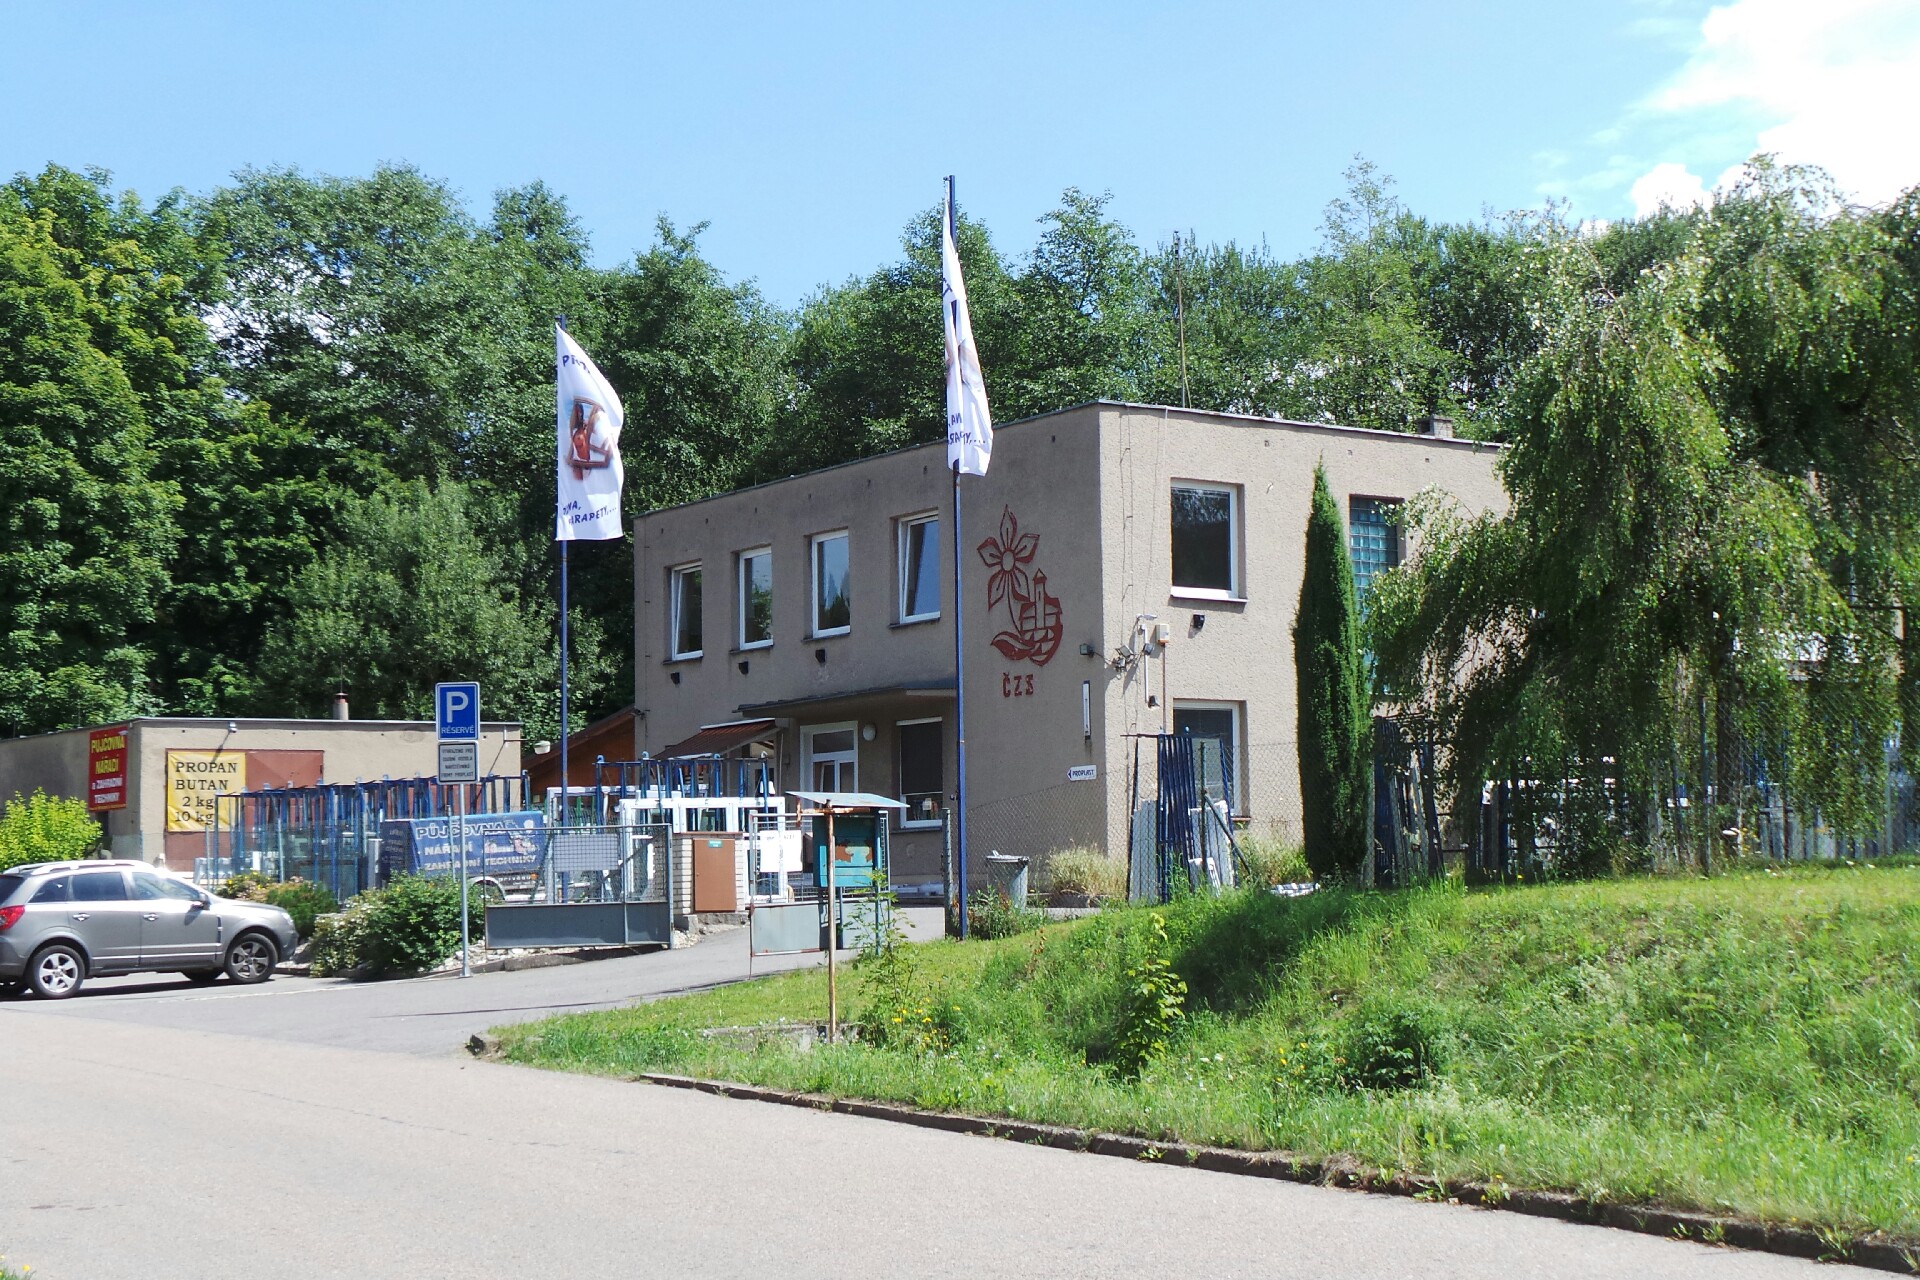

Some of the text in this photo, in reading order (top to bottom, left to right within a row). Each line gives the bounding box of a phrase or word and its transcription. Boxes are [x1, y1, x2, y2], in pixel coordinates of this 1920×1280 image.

[446, 691, 469, 723] P
[441, 725, 475, 734] RÉSERVÉ
[175, 761, 237, 773] PROPAN
[1072, 769, 1095, 778] PROPLAST
[175, 779, 229, 791] BUTAN
[182, 796, 214, 810] 2 kg
[175, 811, 214, 826] 10 kg
